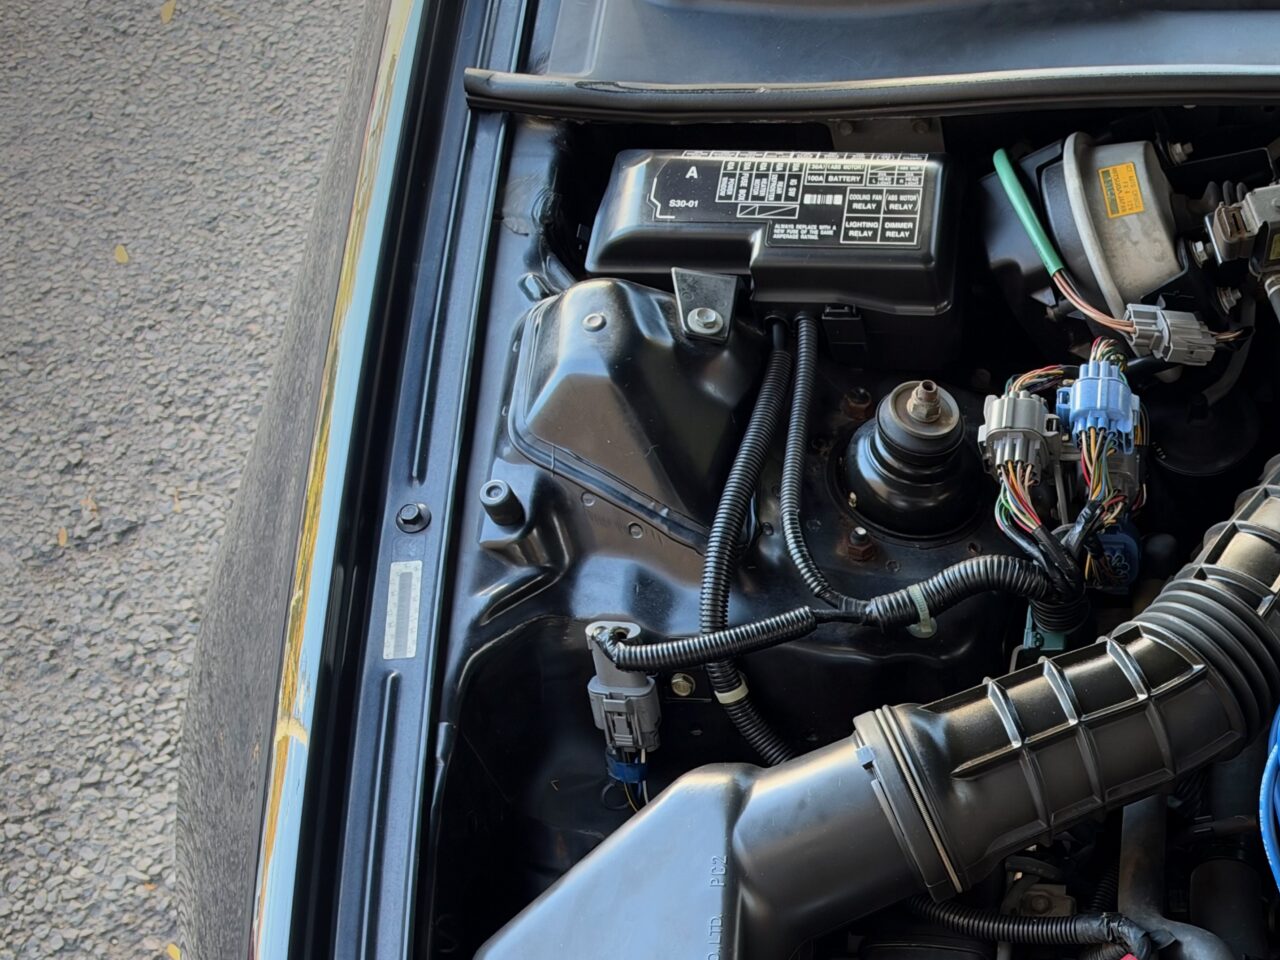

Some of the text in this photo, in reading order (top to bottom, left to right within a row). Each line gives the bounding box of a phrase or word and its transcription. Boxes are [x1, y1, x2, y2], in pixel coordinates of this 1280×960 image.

[685, 166, 698, 179] A
[827, 174, 861, 182] BATTERY
[669, 199, 699, 208] S30-01
[852, 202, 877, 210] RELAY
[845, 221, 879, 229] LIGHTING
[884, 222, 913, 230] DIMMER
[848, 230, 873, 238] RELAY
[885, 231, 910, 239] RELAY
